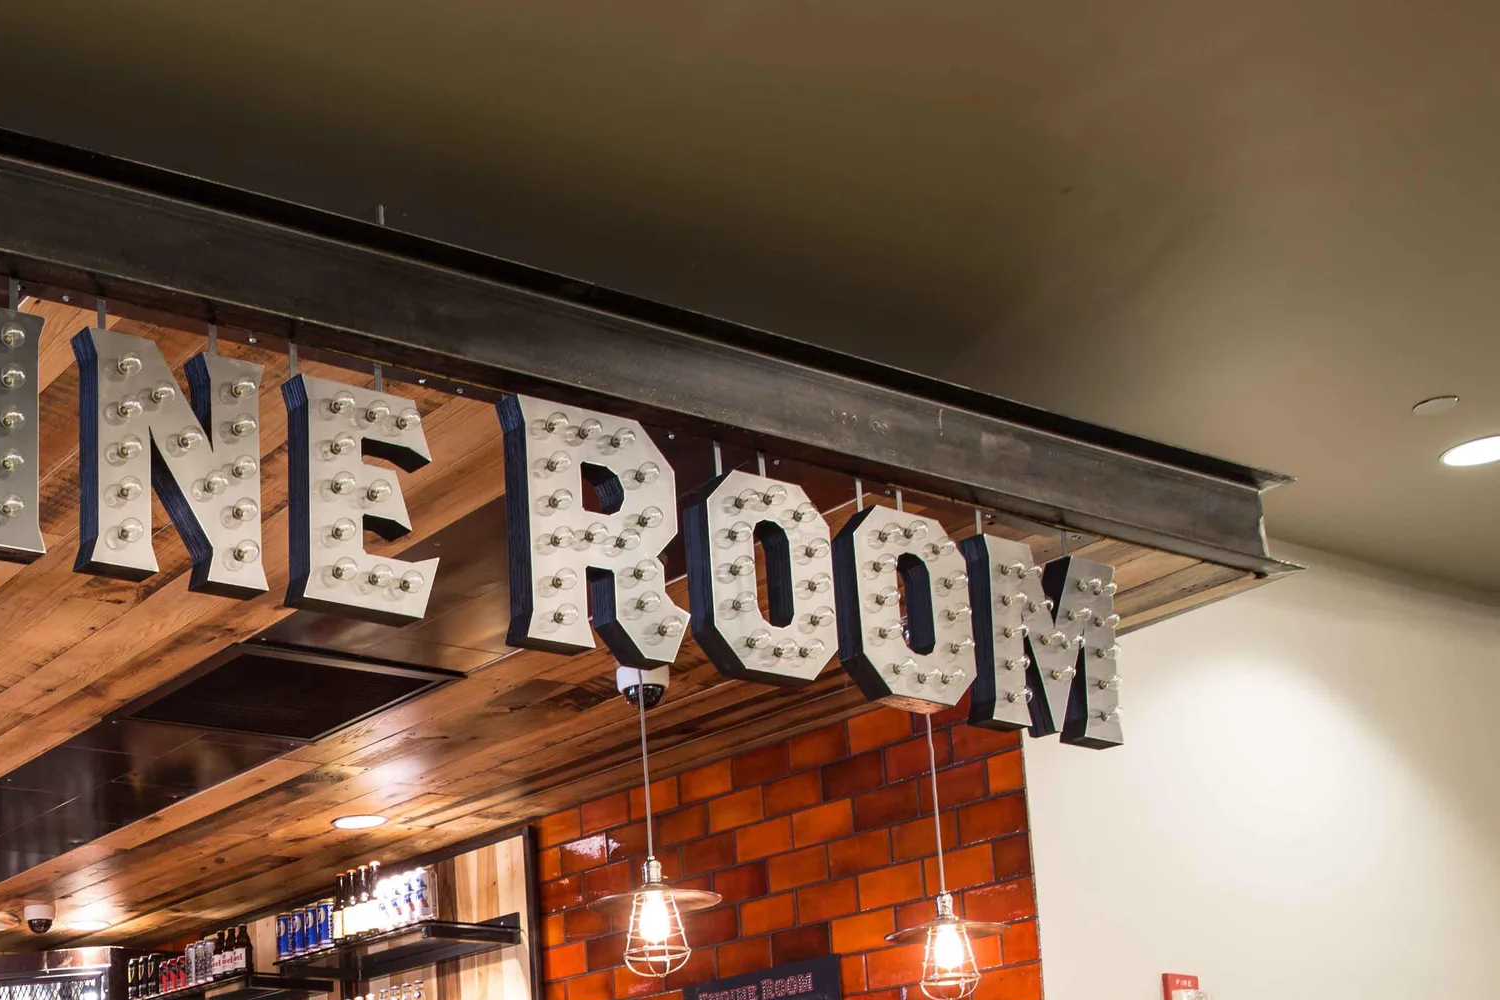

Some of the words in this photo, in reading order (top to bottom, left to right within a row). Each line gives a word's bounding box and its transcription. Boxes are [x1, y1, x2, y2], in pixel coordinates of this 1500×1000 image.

[496, 394, 1123, 749] ROOM
[760, 972, 814, 1000] ROOM
[1175, 978, 1193, 988] FIRE
